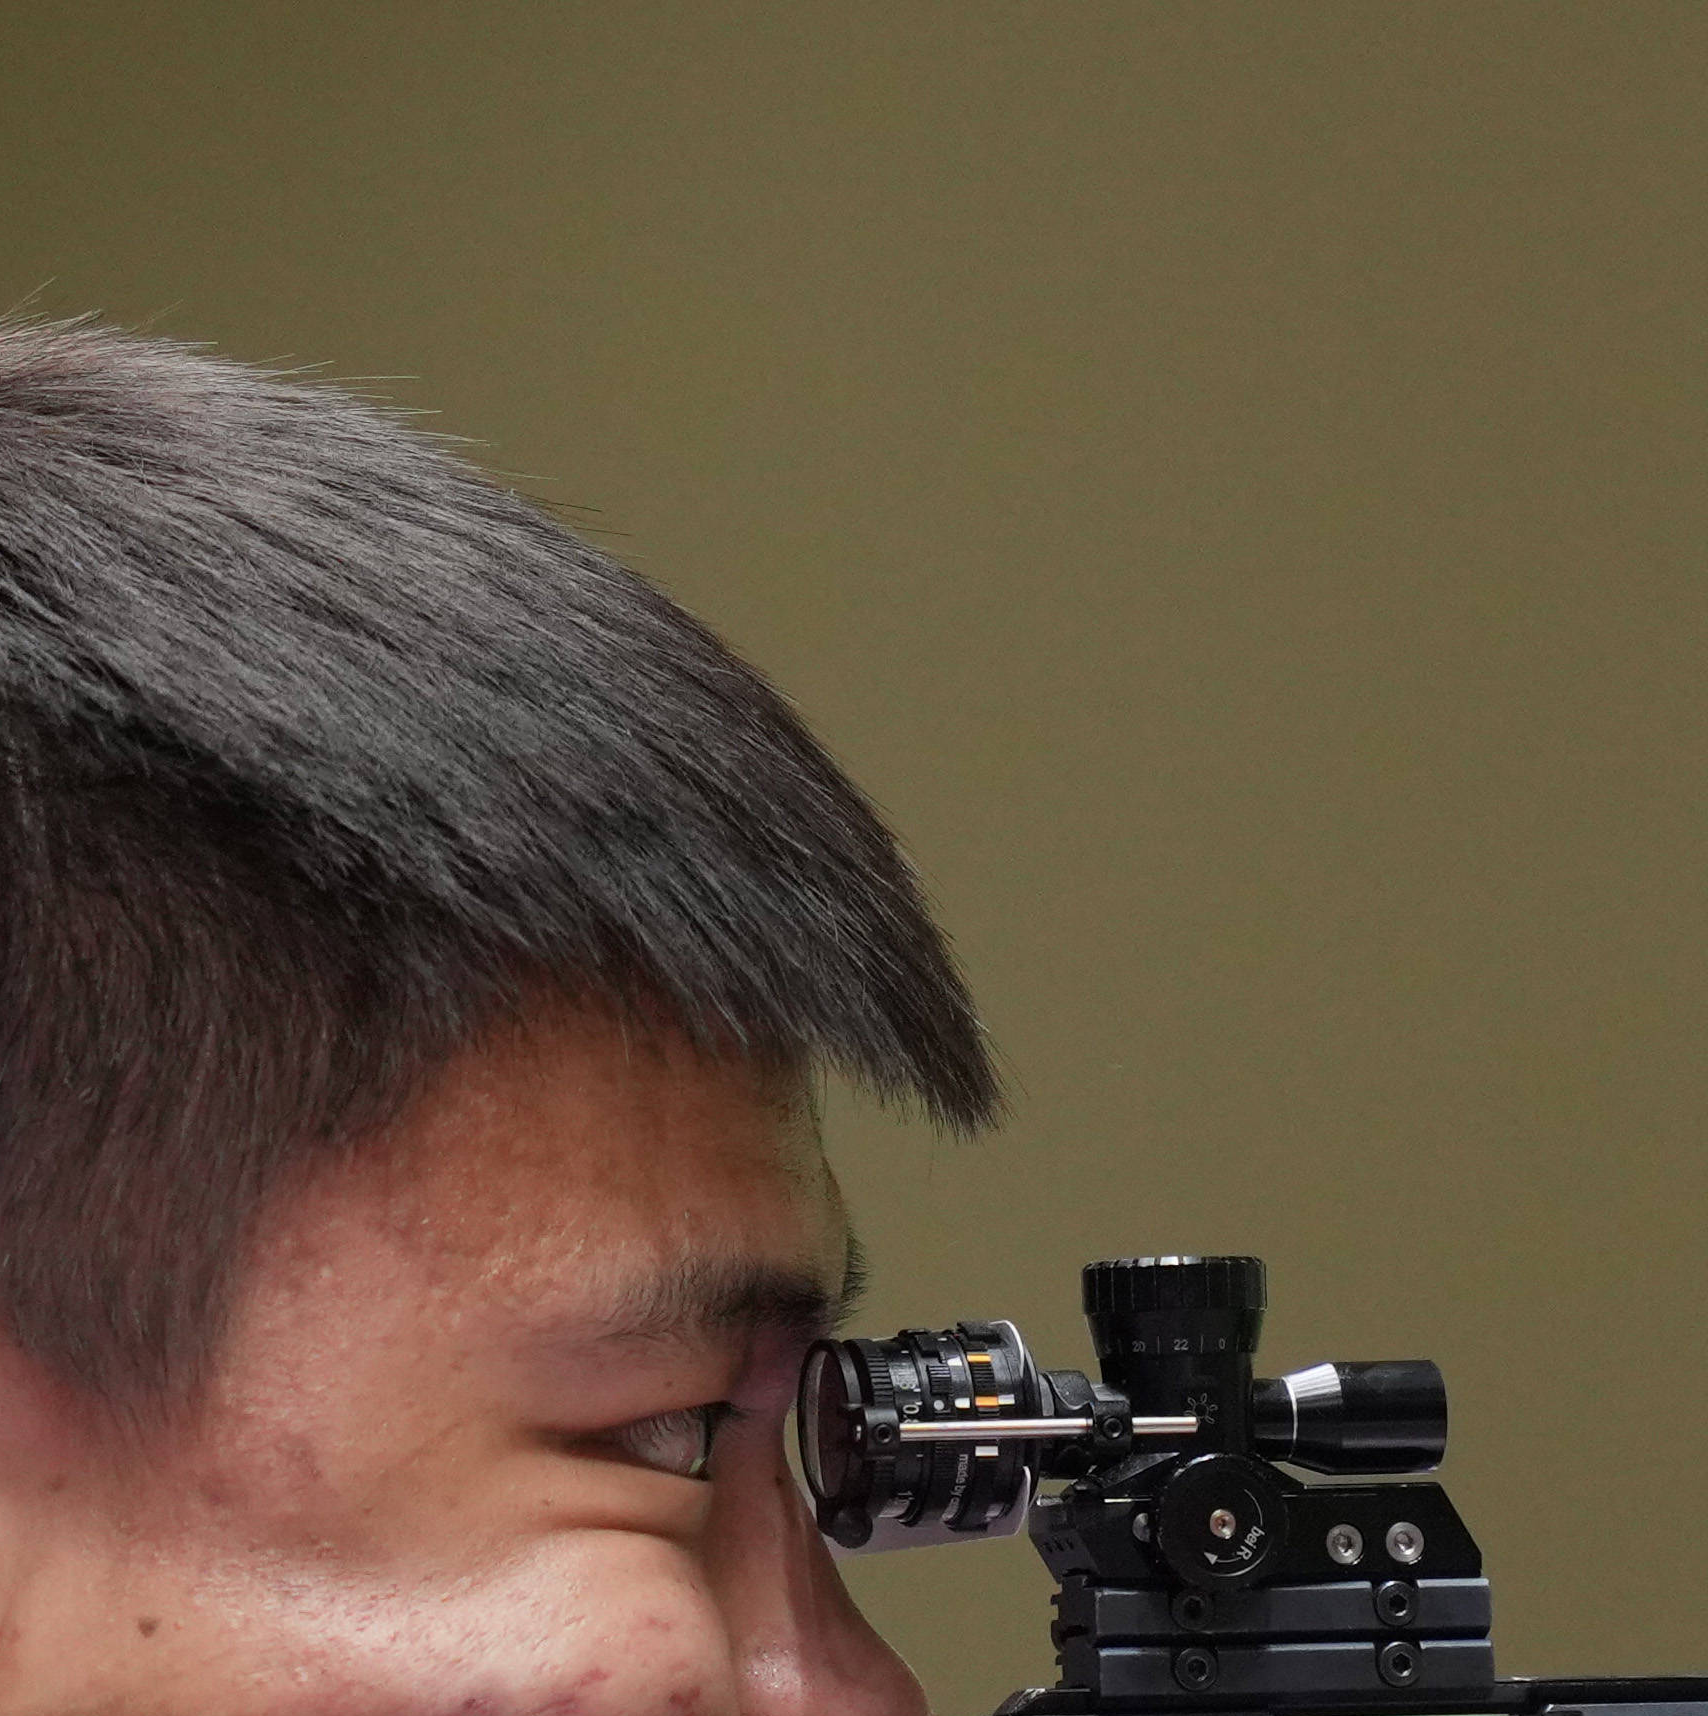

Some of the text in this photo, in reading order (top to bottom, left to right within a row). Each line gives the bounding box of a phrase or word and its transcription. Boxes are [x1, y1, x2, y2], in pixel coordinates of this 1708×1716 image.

[1131, 1341, 1146, 1354] 20
[1173, 1339, 1190, 1353] 22
[955, 1453, 970, 1485] made
[948, 1484, 968, 1499] by
[1235, 1525, 1266, 1561] bei R
